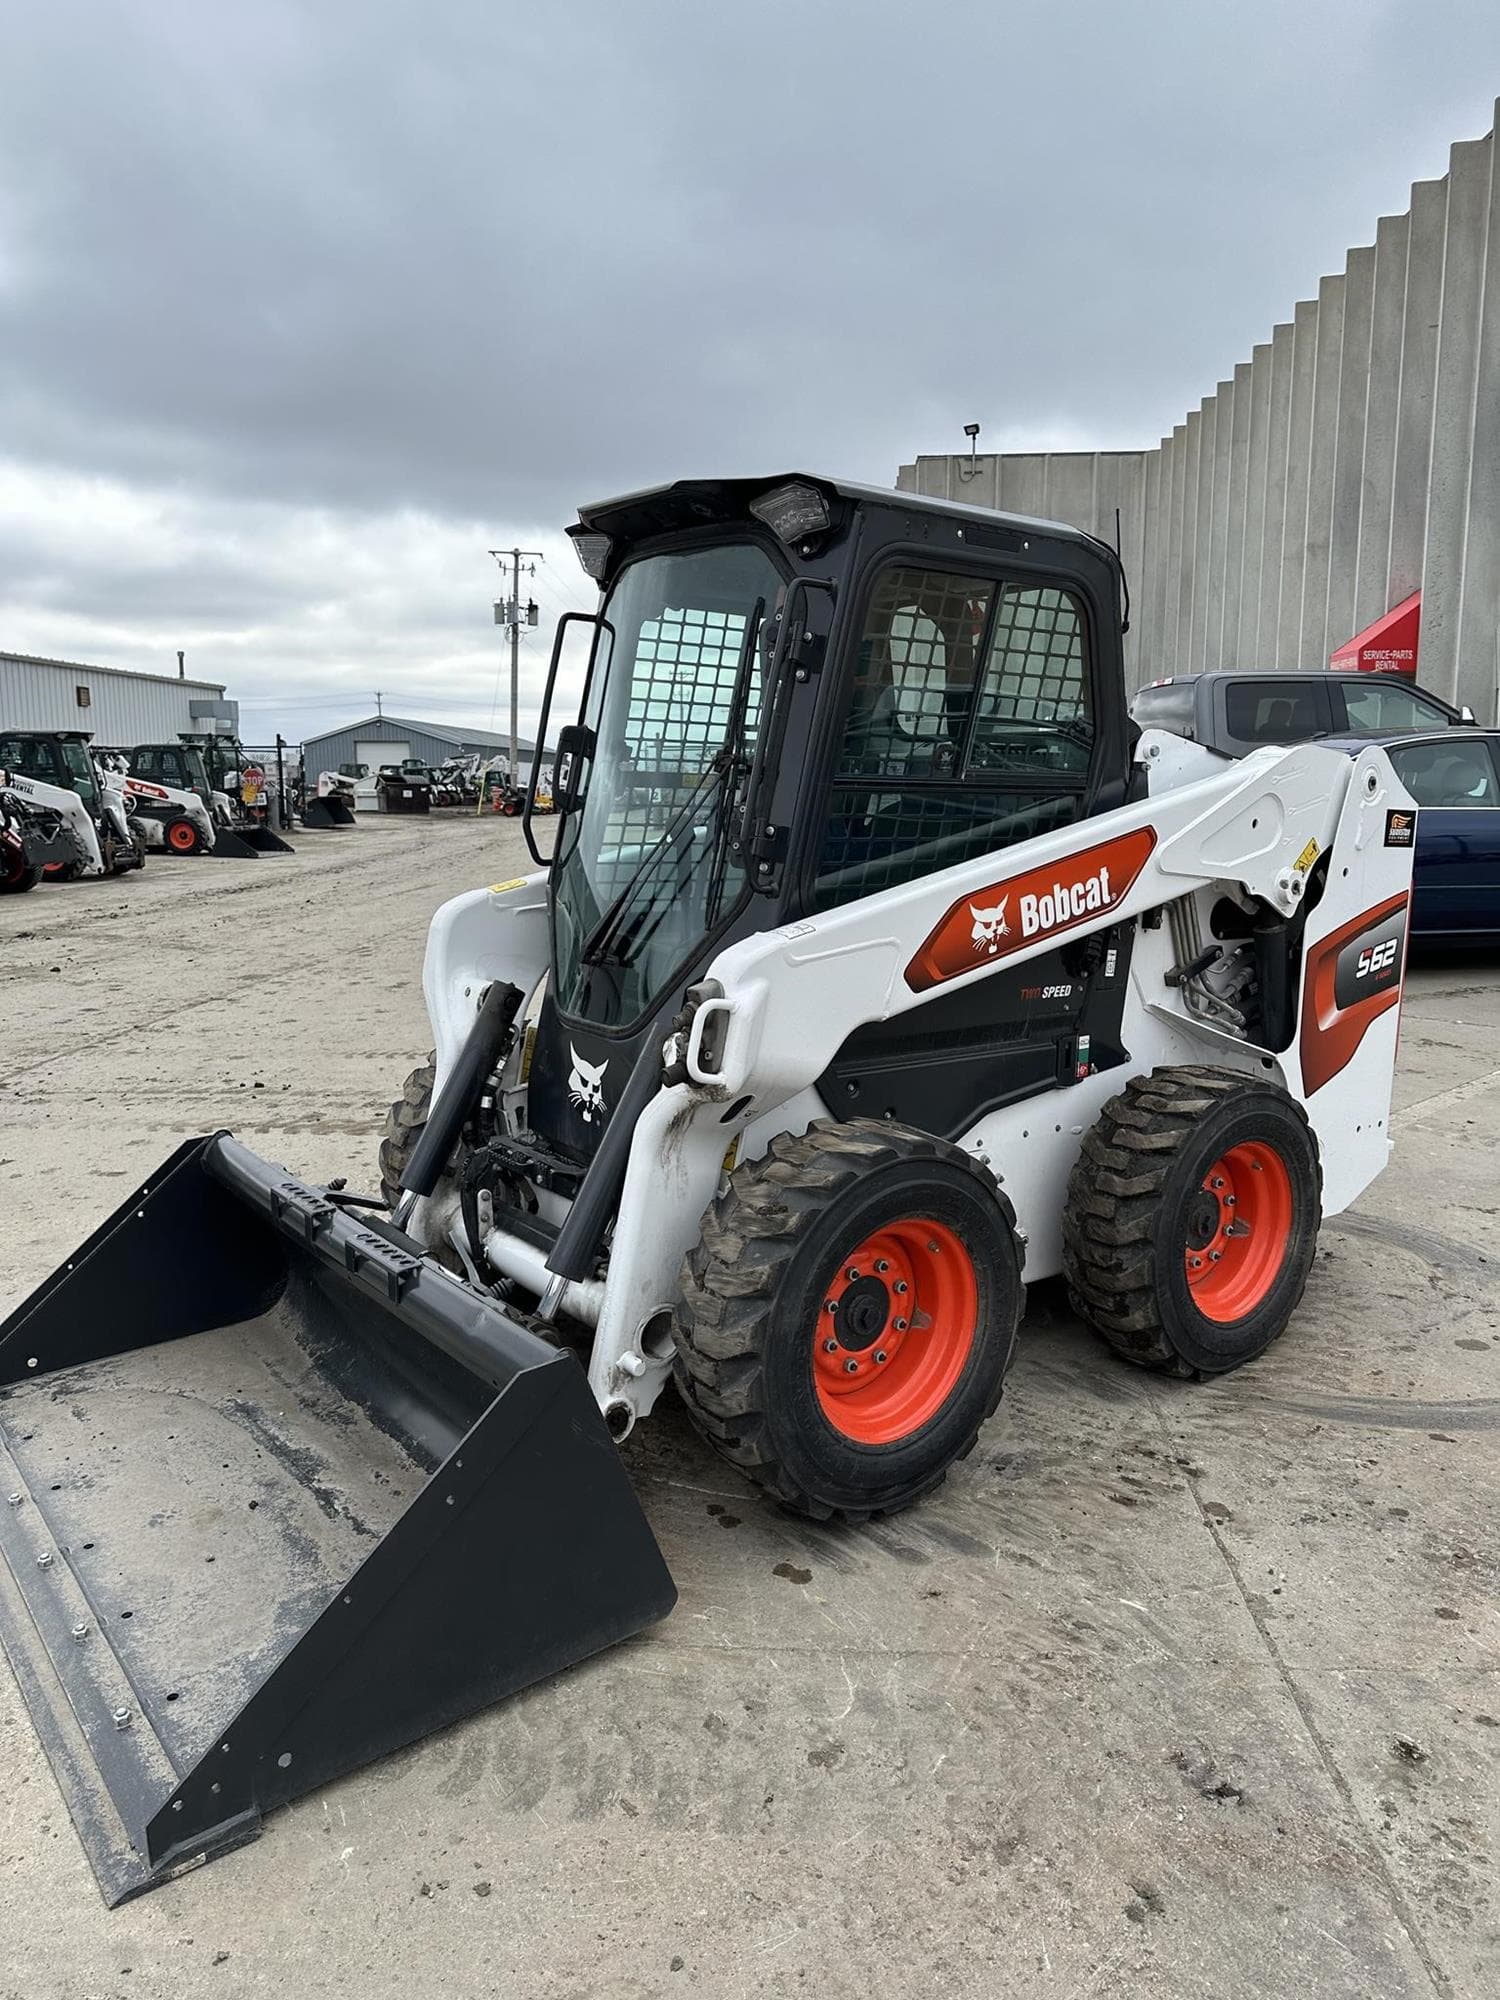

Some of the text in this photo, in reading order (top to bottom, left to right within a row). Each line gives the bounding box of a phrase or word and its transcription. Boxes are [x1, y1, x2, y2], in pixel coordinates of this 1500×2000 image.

[1375, 660, 1400, 670] RENTAL
[1019, 866, 1112, 938] Bobcat
[1356, 938, 1398, 979] S62
[1041, 984, 1072, 999] SPEED
